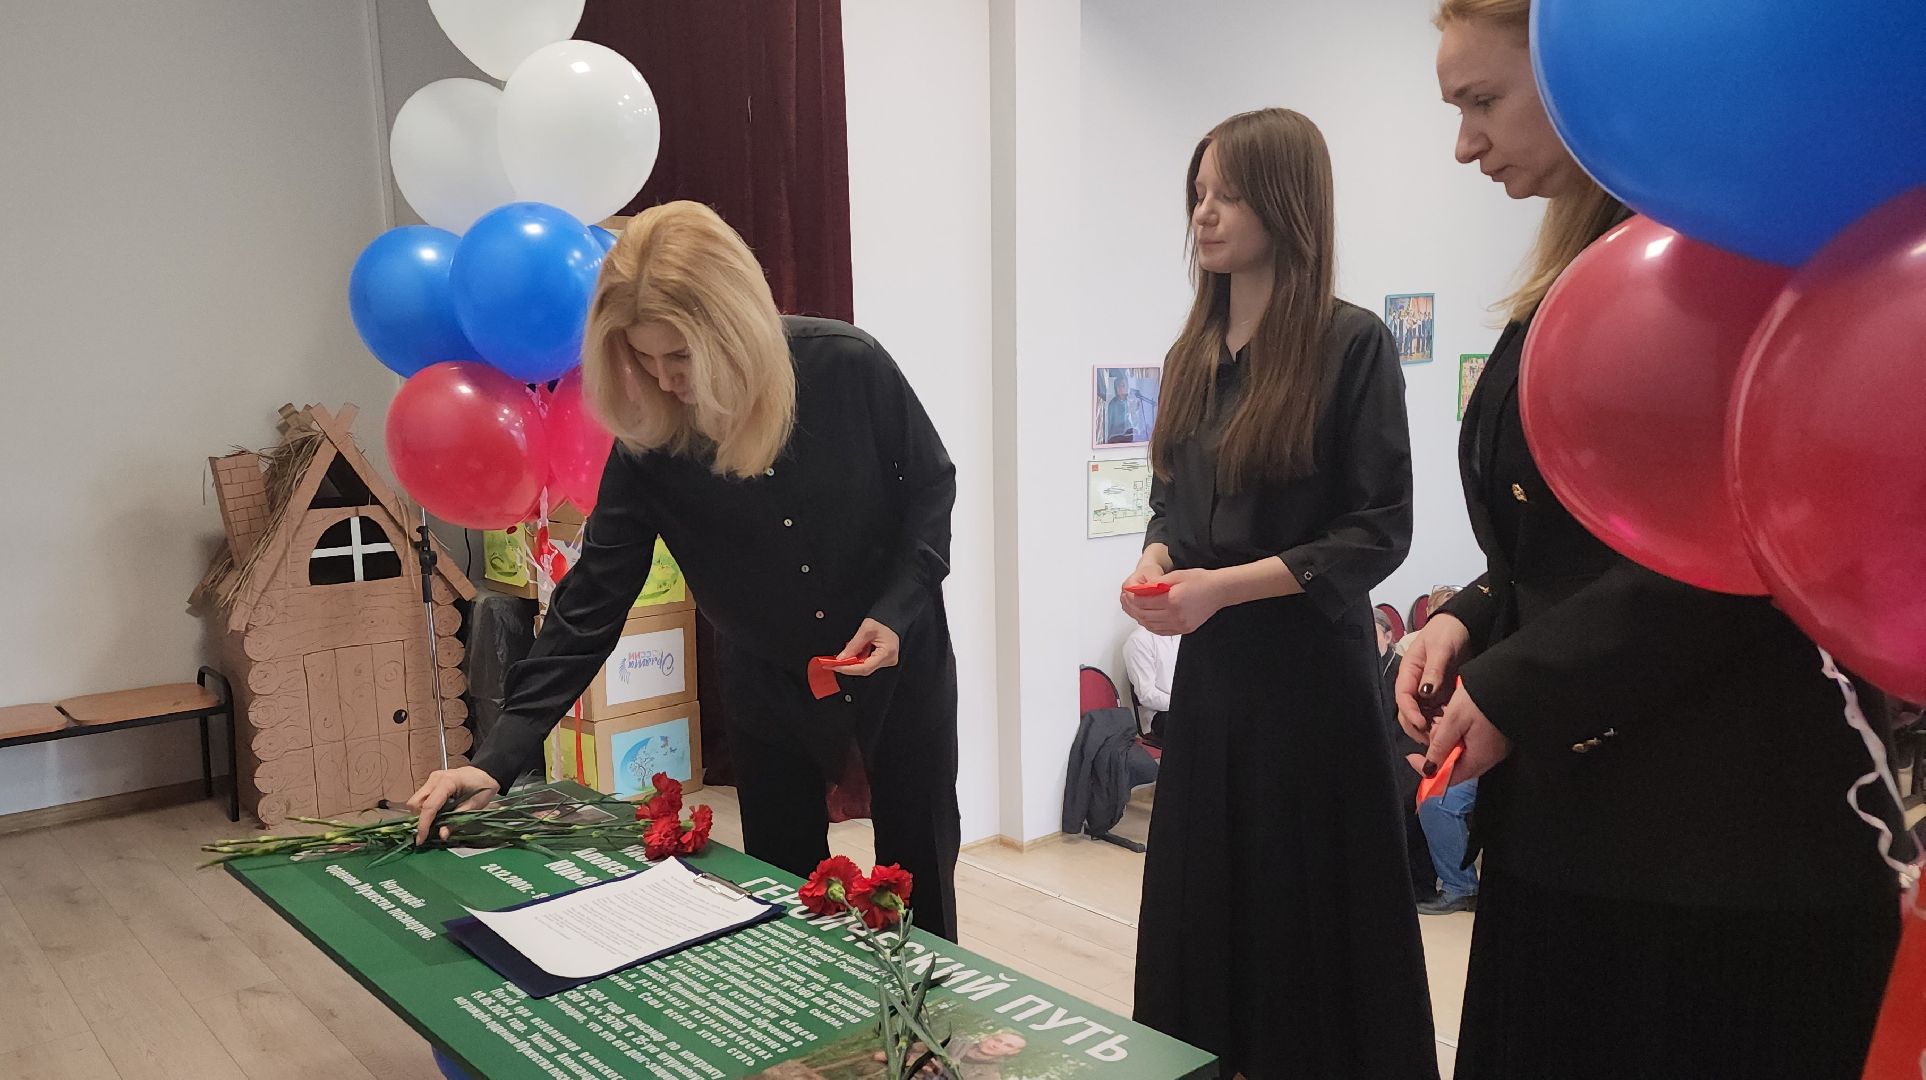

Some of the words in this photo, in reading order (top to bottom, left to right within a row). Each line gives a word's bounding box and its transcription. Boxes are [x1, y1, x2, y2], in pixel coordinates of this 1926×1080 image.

[353, 883, 395, 910] Мужества
[388, 908, 436, 940] посмертно.
[667, 969, 710, 993] Александр
[752, 1017, 795, 1042] обучение
[674, 961, 714, 982] аттестат
[729, 991, 779, 1019] основном
[807, 982, 825, 991] где
[831, 983, 880, 1008] Александр
[490, 988, 520, 1005] Погиб
[514, 1006, 533, 1017] при
[530, 1017, 581, 1051] исполнении
[507, 1018, 527, 1033] года.
[584, 989, 608, 1002] 2024
[604, 1002, 625, 1014] года
[623, 1014, 667, 1041] Александр
[665, 1042, 680, 1050] по
[679, 1050, 726, 1079] контракту
[587, 1022, 603, 1032] что
[599, 1031, 616, 1041] это
[612, 1040, 631, 1050] его
[635, 979, 690, 1009] различных
[689, 1010, 773, 1059] патриотических
[638, 992, 664, 1008] Саша
[663, 1009, 697, 1029] всегда
[696, 1029, 727, 1047] хотел
[727, 1048, 755, 1066] стать
[706, 1006, 747, 1029] активное
[740, 1027, 780, 1049] участие
[809, 1009, 844, 1029] сыном,
[993, 993, 1129, 1064] ПУТЬ
[514, 1041, 554, 1070] Мужества
